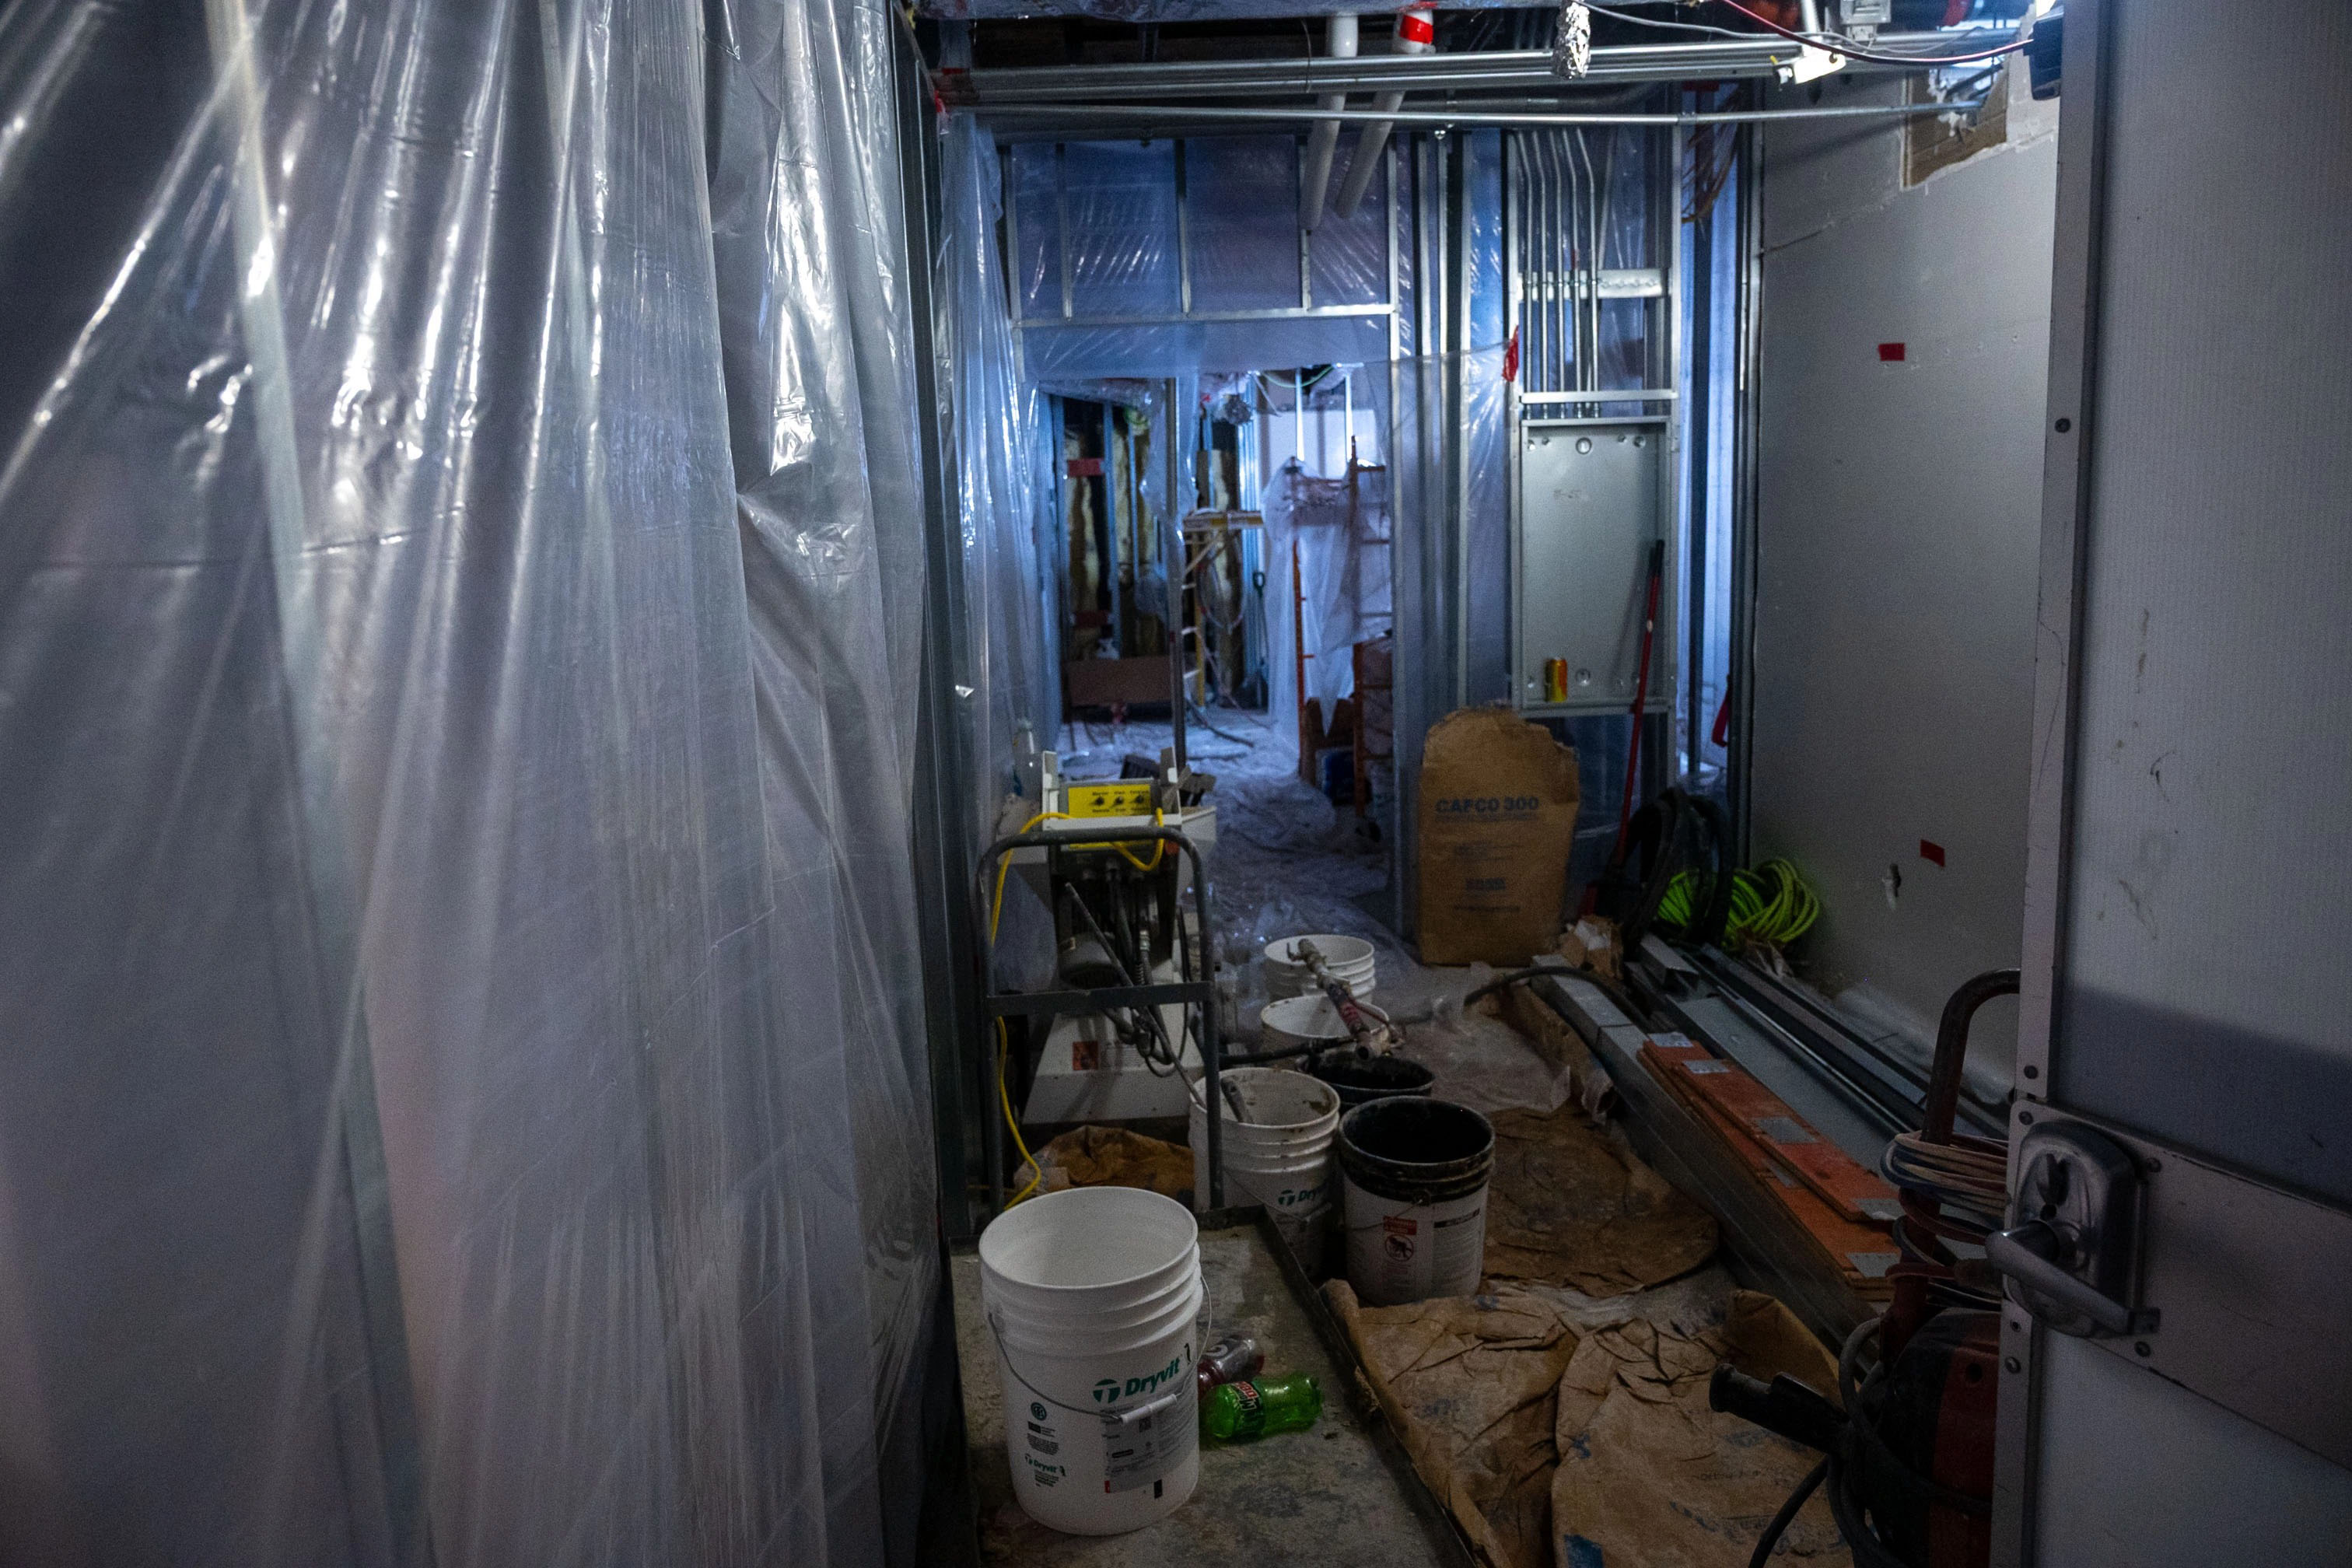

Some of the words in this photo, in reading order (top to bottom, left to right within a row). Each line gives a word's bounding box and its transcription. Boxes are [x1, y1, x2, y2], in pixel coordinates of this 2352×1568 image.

[1436, 797, 1500, 813] CAFCO
[1504, 796, 1539, 810] 300
[1125, 1357, 1180, 1397] Dryvit
[1034, 1459, 1058, 1473] Dryvit
